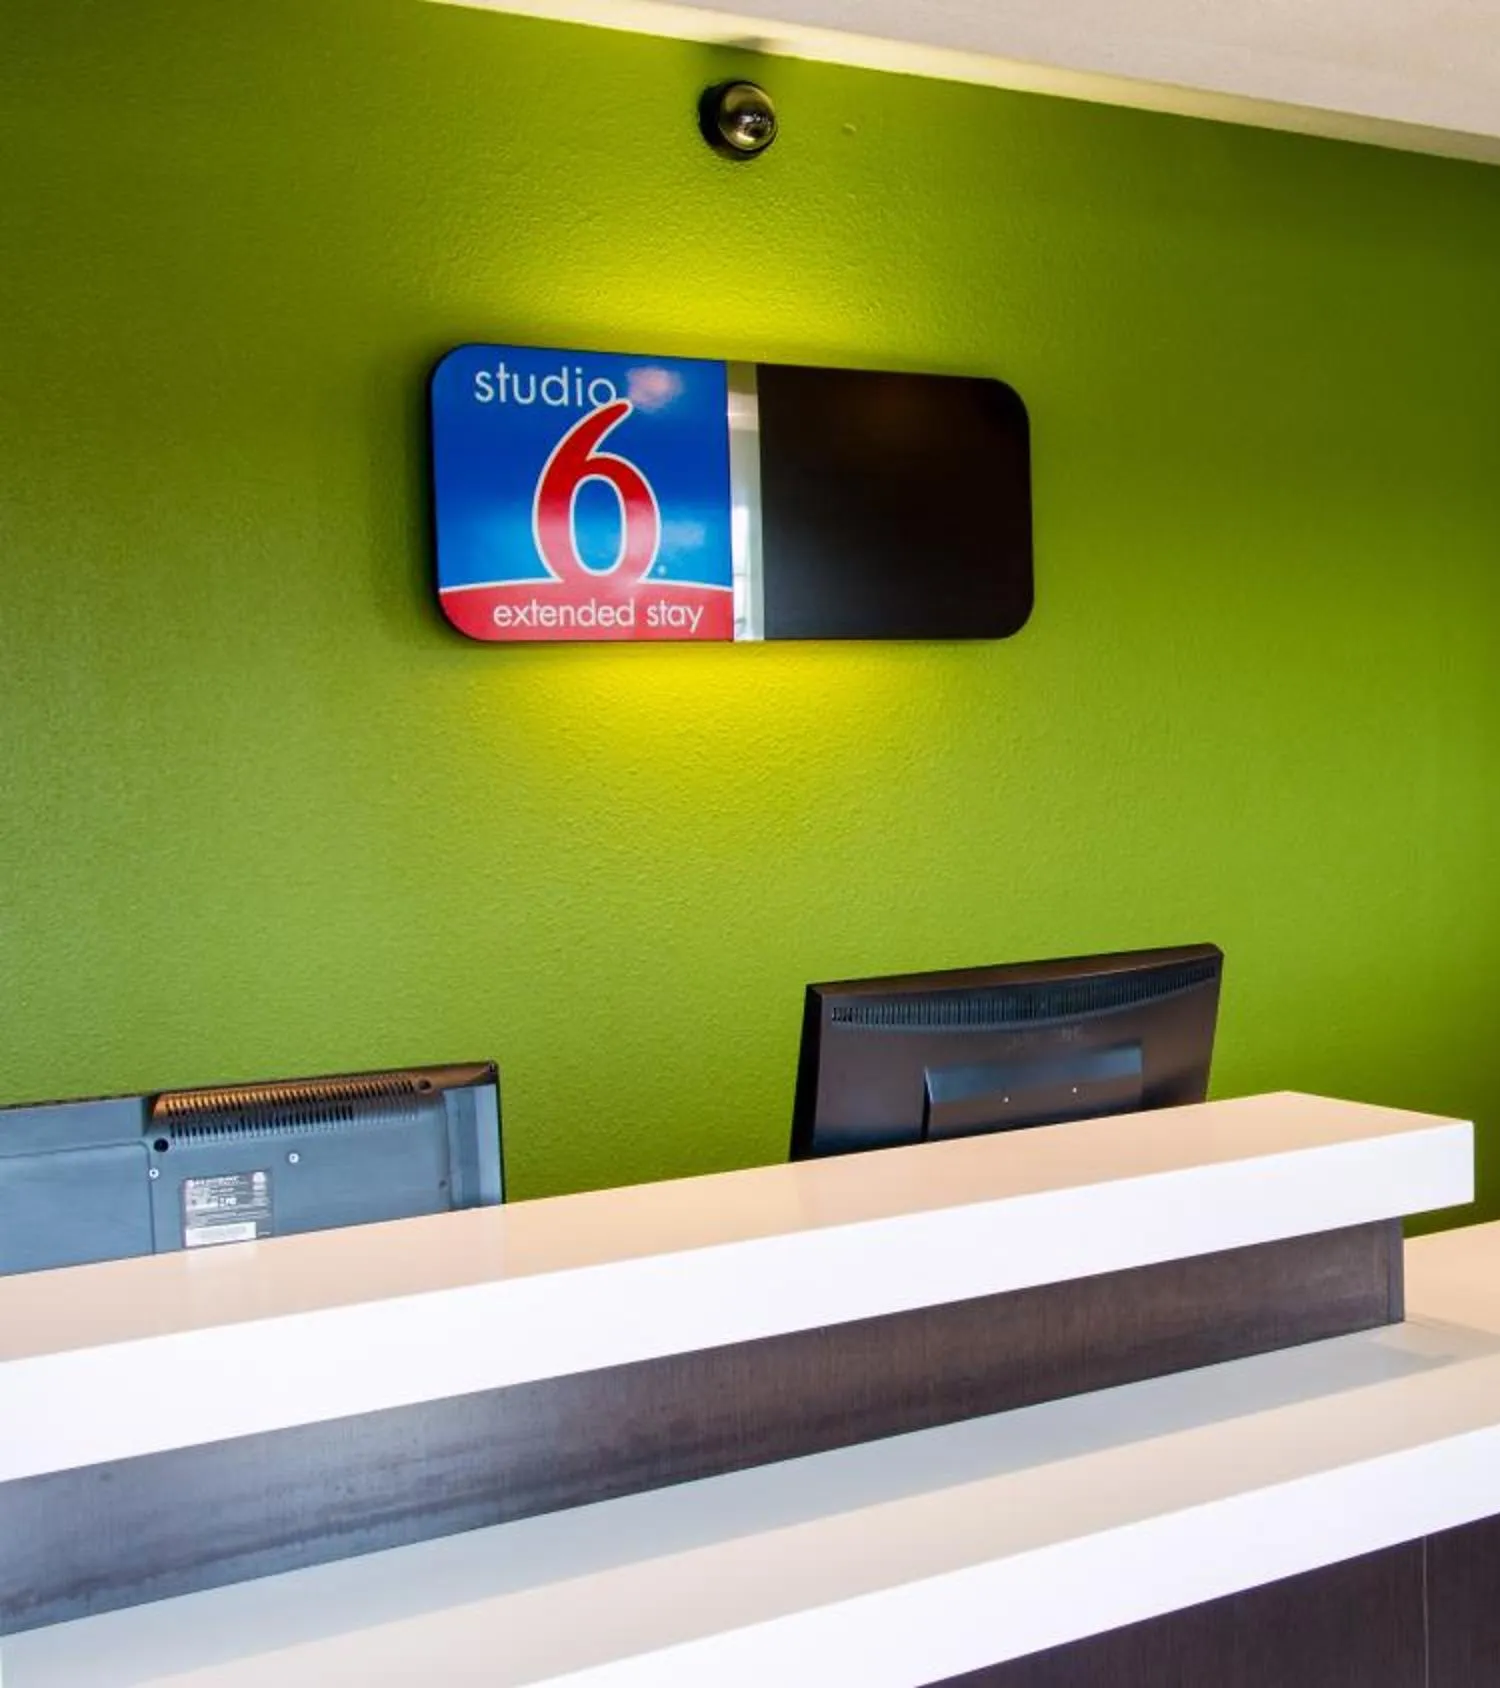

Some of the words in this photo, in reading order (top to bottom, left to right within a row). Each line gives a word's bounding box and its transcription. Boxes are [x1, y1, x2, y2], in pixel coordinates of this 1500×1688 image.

[474, 362, 617, 407] studio
[531, 399, 662, 585] 6
[493, 597, 635, 628] extended
[646, 600, 705, 634] stay
